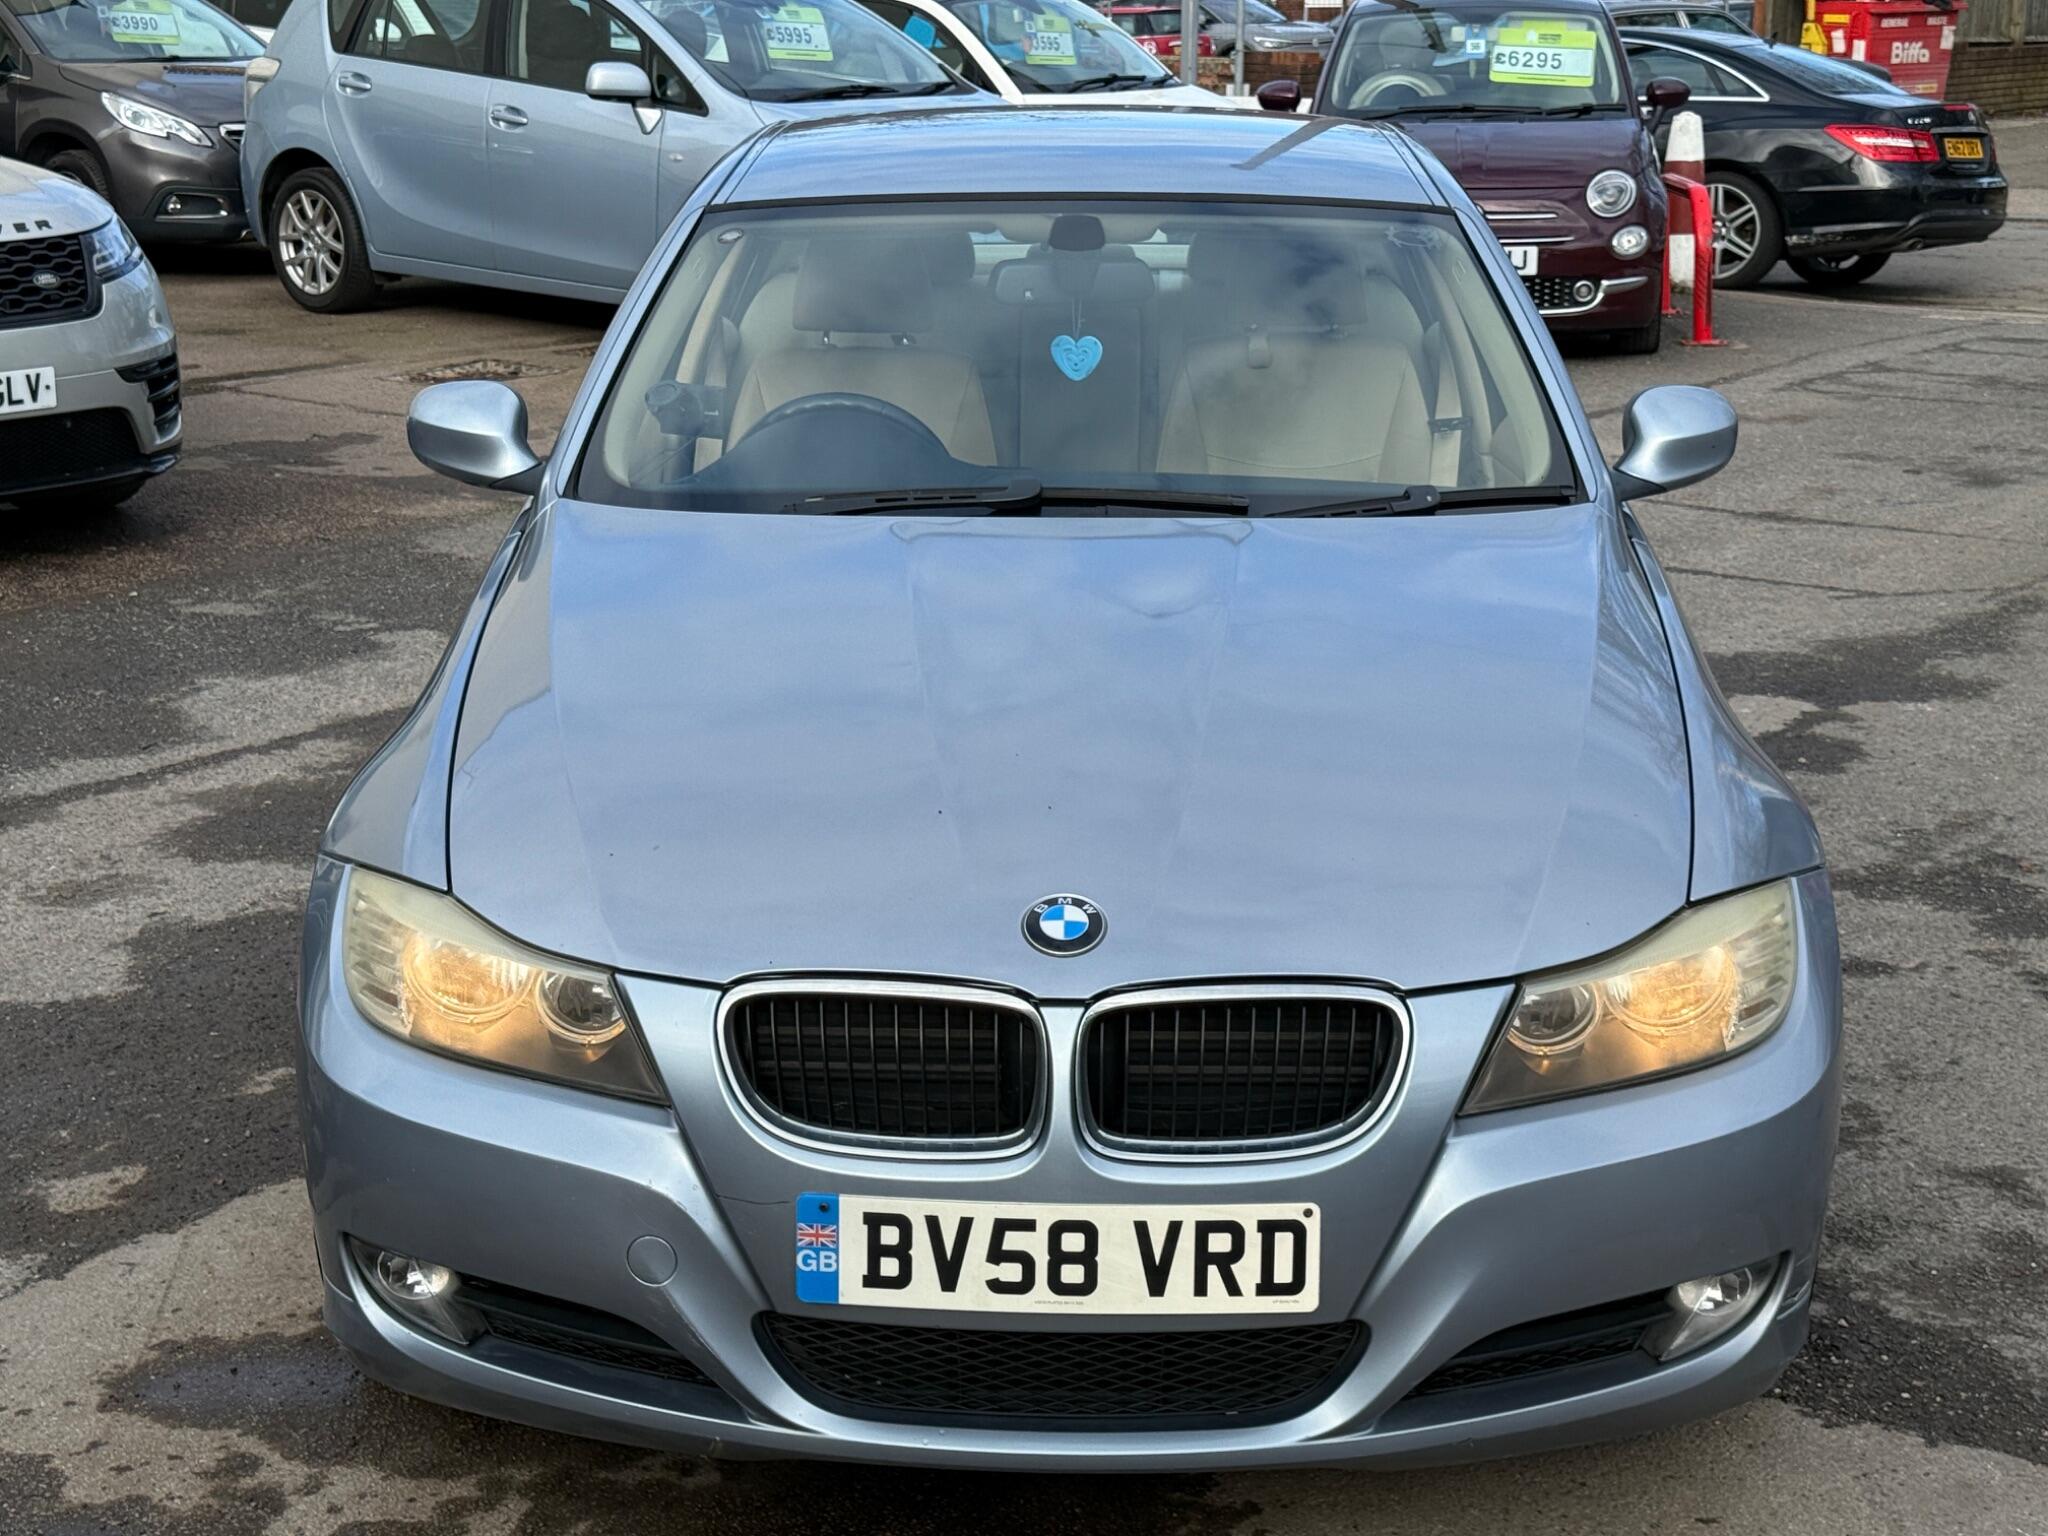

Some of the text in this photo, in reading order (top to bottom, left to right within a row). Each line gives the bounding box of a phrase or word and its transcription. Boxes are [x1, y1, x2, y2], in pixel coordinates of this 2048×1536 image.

[111, 15, 158, 31] £3990
[766, 26, 812, 44] £5995
[1494, 50, 1562, 70] £6295
[1890, 41, 1930, 64] Biffa
[0, 219, 53, 235] ER
[1033, 897, 1098, 915] BMW
[796, 1249, 838, 1273] GB
[861, 1211, 1307, 1298] BV58 VRD
